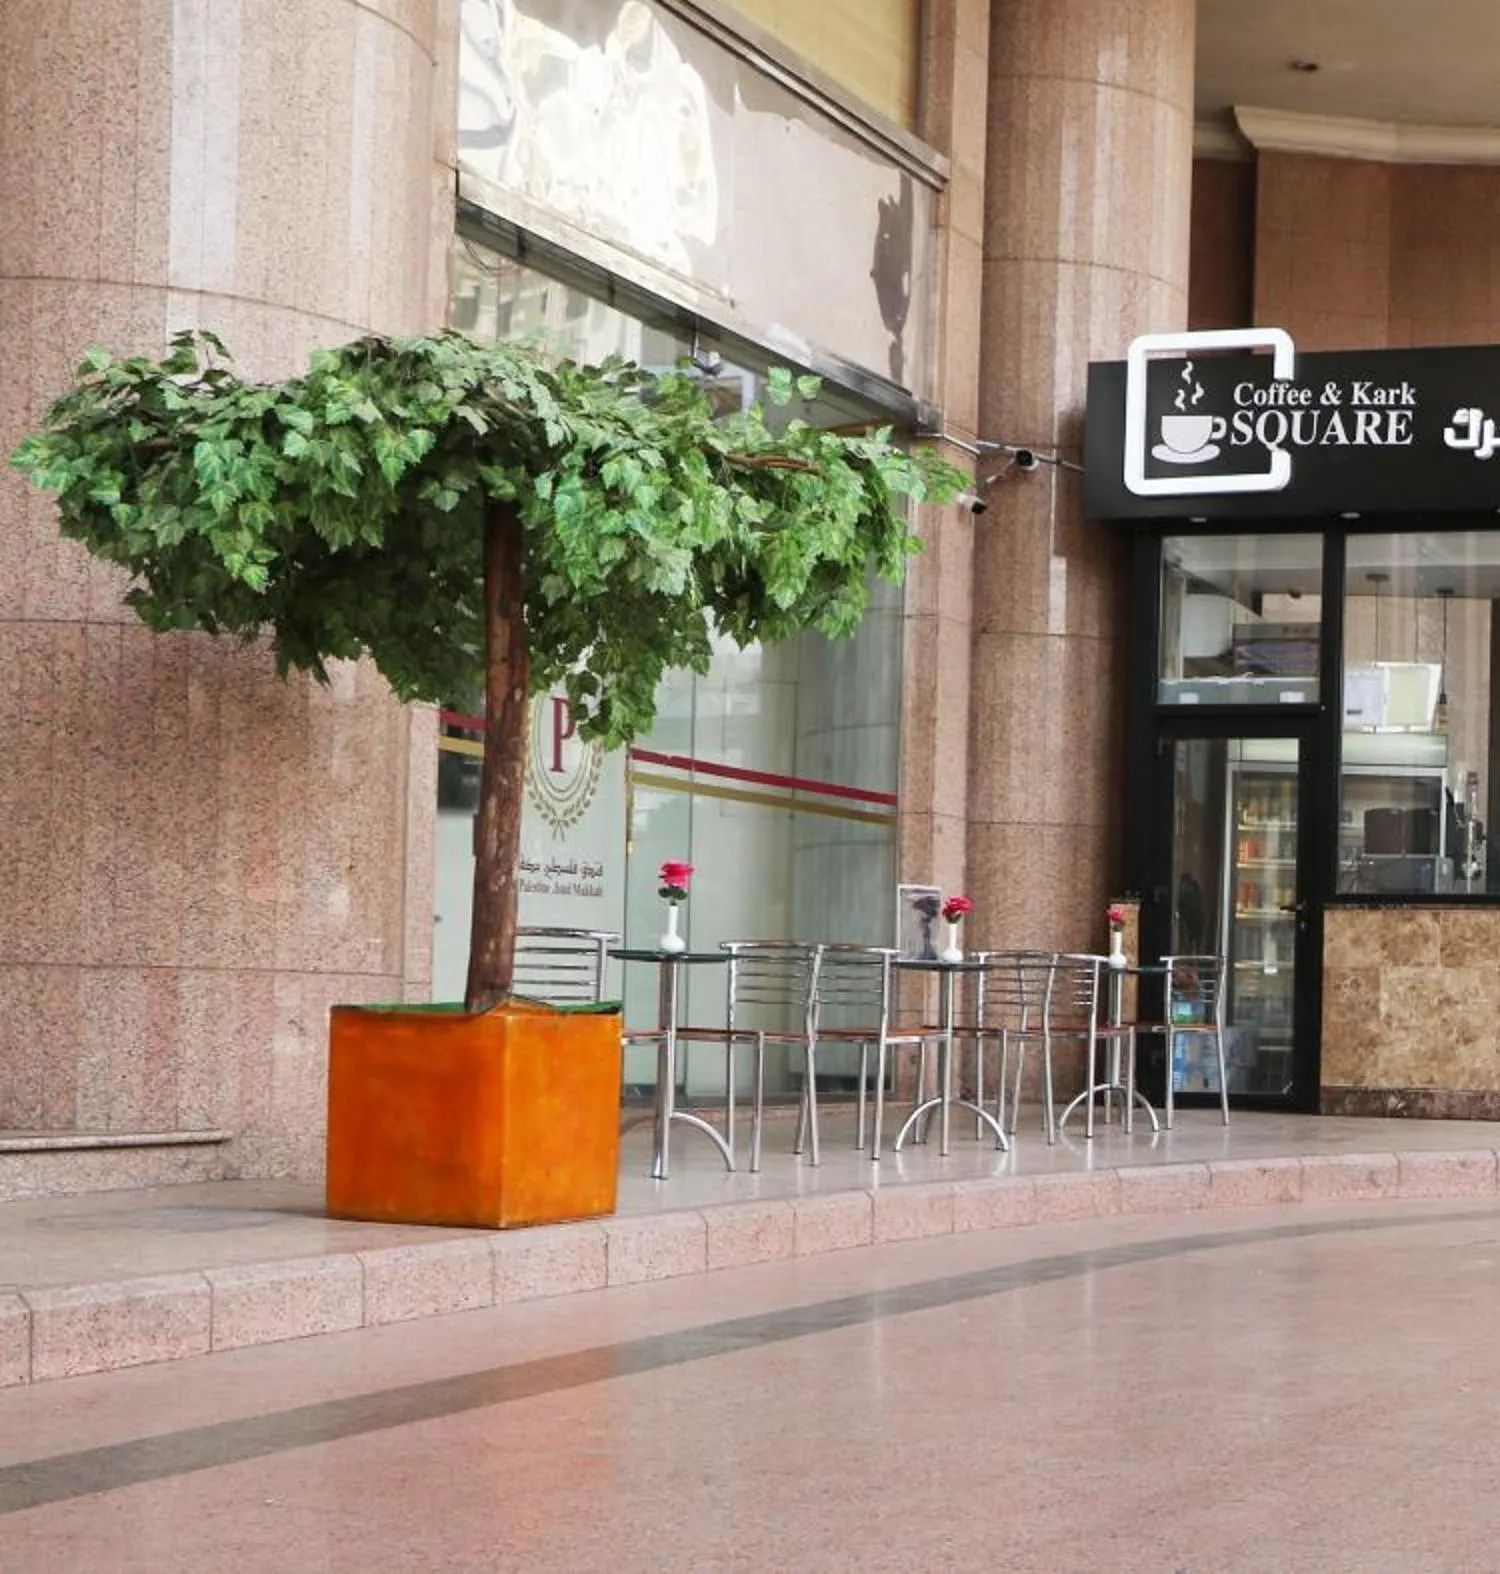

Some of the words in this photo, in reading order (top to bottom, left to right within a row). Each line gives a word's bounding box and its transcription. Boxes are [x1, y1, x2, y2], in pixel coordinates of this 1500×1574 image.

[1233, 382, 1312, 407] Coffee
[1319, 381, 1342, 406] &
[1351, 381, 1416, 406] Kark
[1230, 409, 1413, 450] SQUARE
